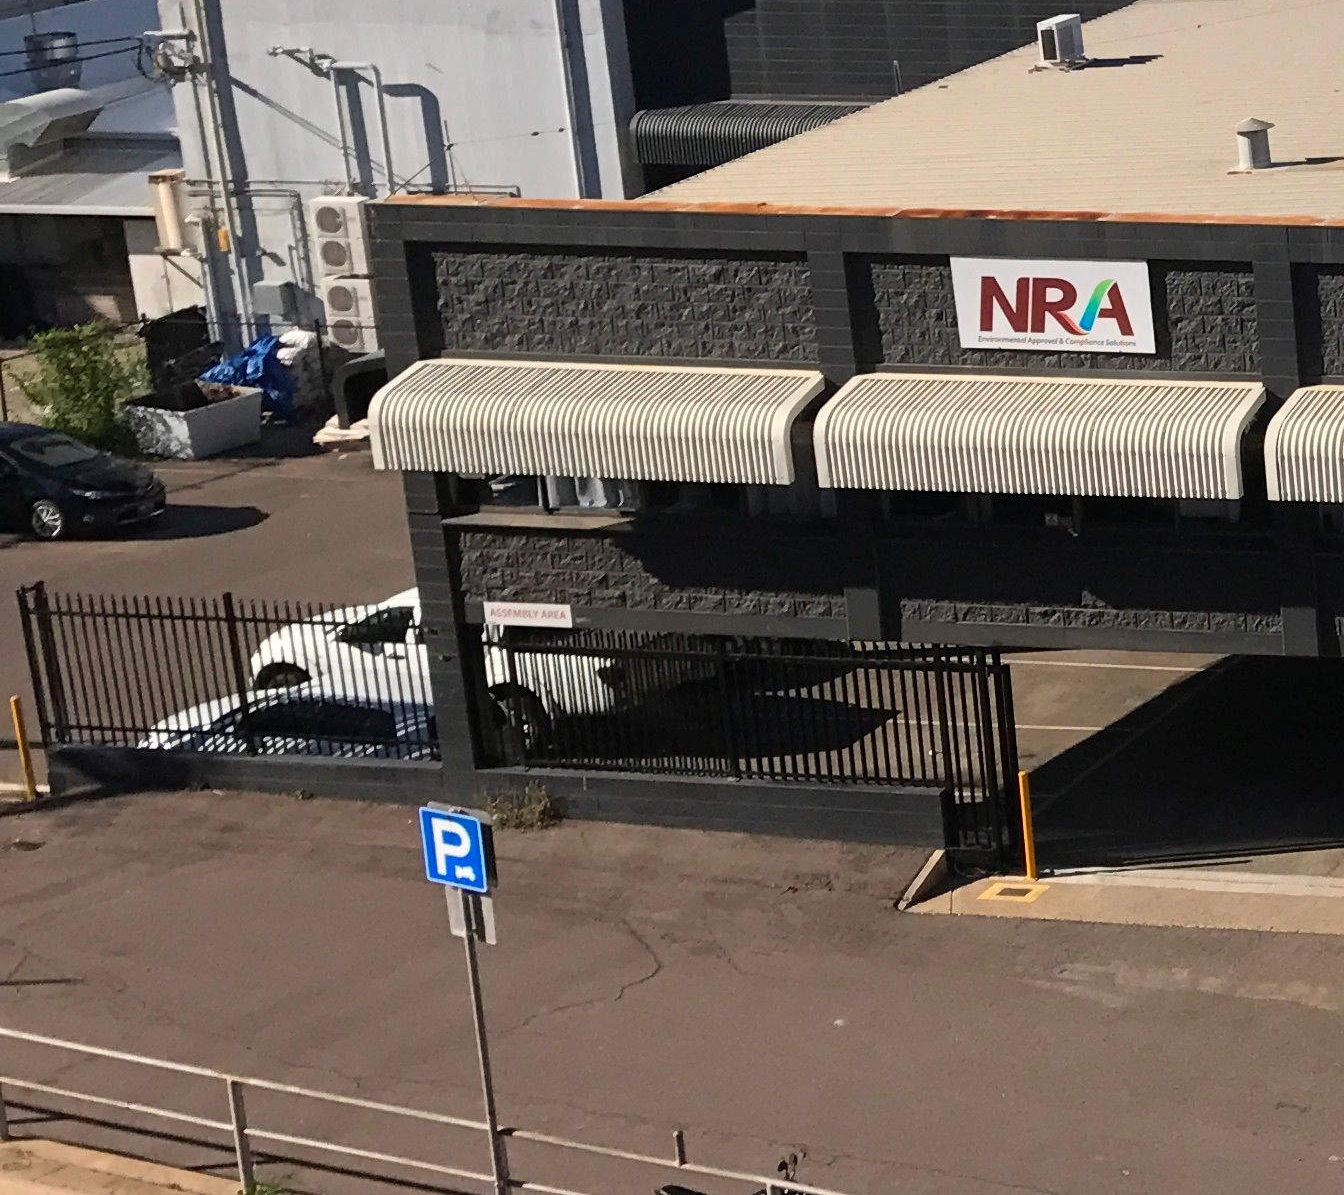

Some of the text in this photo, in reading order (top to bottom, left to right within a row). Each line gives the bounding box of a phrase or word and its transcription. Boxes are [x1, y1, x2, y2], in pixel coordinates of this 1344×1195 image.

[979, 276, 1135, 336] NRA
[977, 335, 1026, 344] Environmental
[1027, 336, 1058, 345] Approval
[1065, 338, 1105, 347] Compliance
[1105, 339, 1137, 347] Solutions
[490, 608, 567, 619] ASSEMBLY AREA
[431, 817, 471, 876] P
